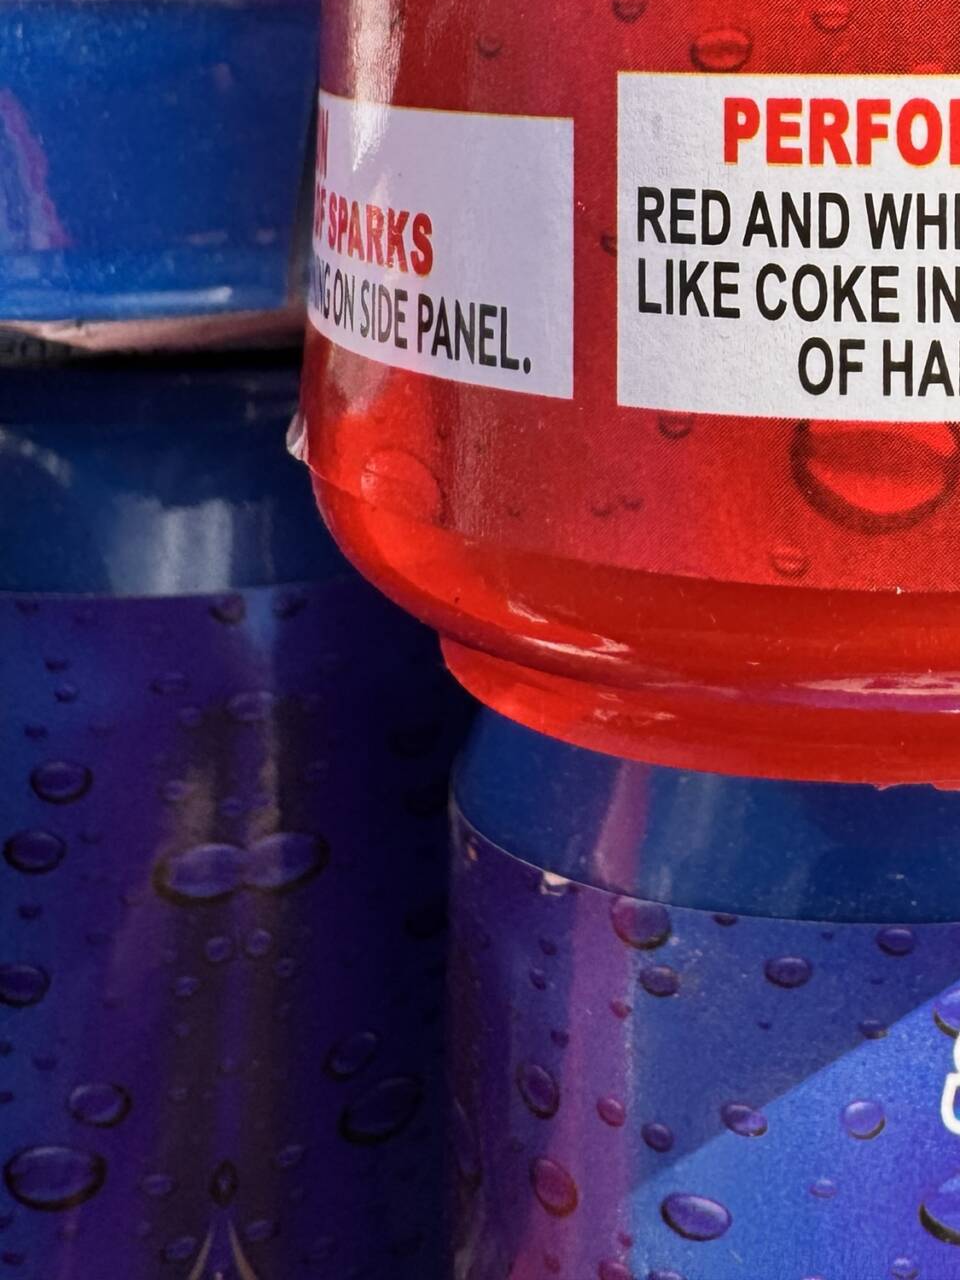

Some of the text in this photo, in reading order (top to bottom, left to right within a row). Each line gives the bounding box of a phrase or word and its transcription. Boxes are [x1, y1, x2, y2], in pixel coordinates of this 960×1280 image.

[328, 191, 434, 277] SPARKS
[636, 186, 731, 246] RED
[743, 190, 850, 250] AND
[333, 268, 355, 333] ON
[360, 279, 409, 349] SIDE
[417, 293, 532, 374] PANEL.
[637, 258, 741, 319] LIKE
[756, 264, 899, 322] COKE
[798, 338, 866, 397] OF
